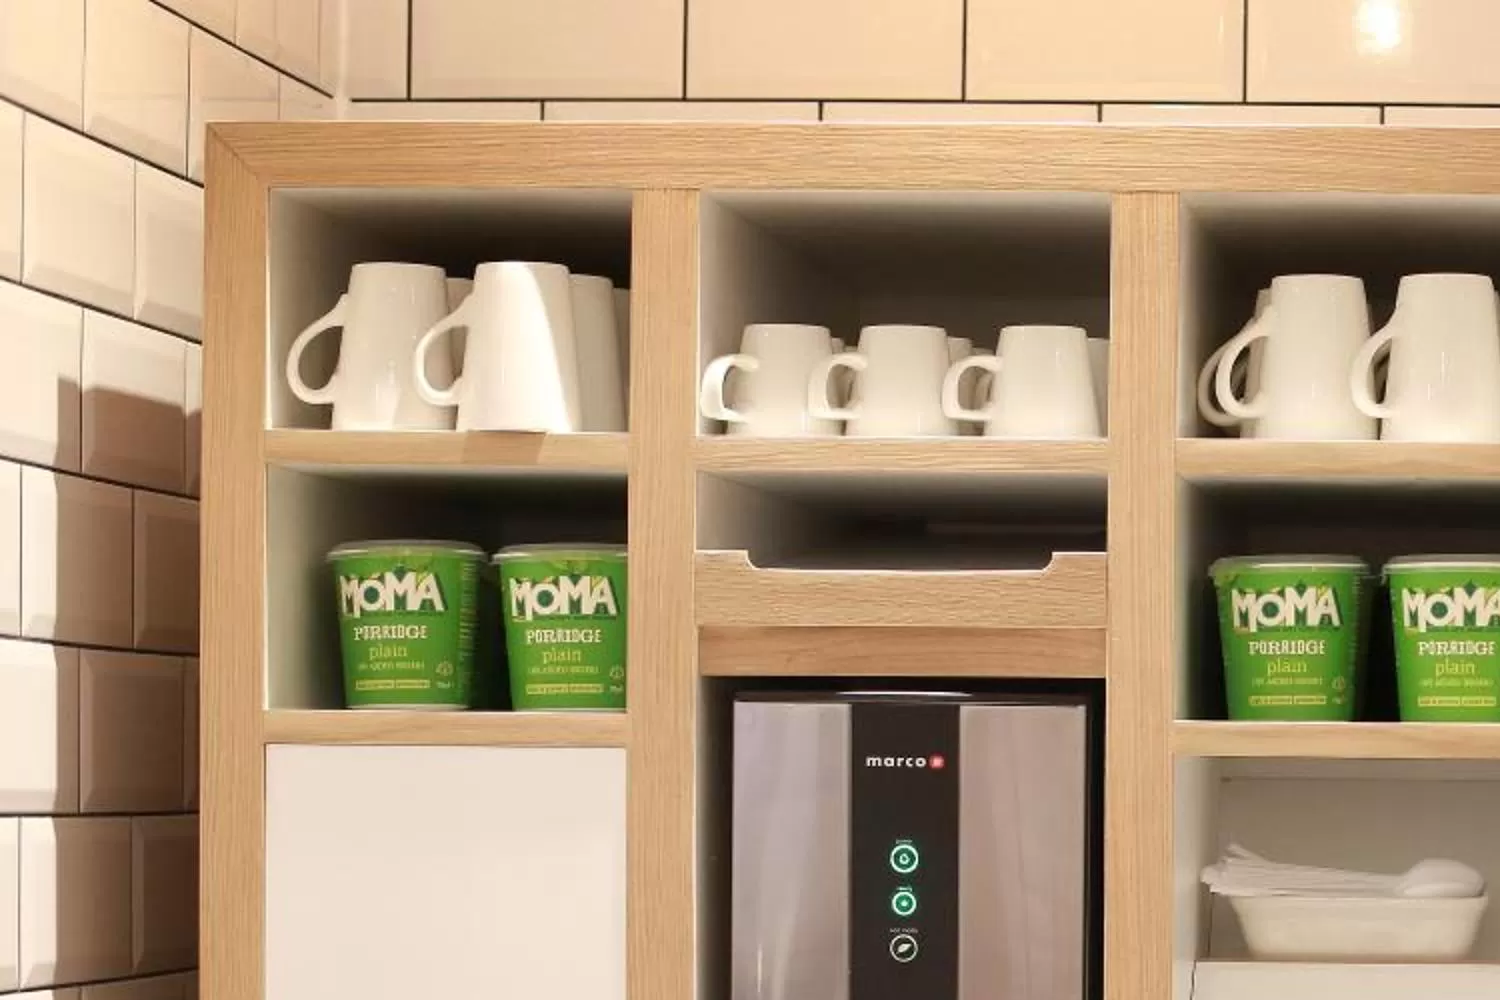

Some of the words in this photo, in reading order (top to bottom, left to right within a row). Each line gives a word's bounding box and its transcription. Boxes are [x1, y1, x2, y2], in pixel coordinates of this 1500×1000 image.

[340, 572, 445, 618] MOMA
[510, 576, 617, 620] MOMA
[1232, 586, 1340, 632] MOMA
[353, 624, 428, 640] PORRIDGE
[526, 629, 602, 644] PORRIDGE
[368, 643, 408, 660] plain
[1248, 639, 1325, 655] PORRIDGE
[1418, 640, 1496, 655] PORRIDGE
[542, 648, 581, 664] plain
[1267, 657, 1307, 676] plain
[1435, 657, 1475, 677] plain
[866, 756, 927, 768] marco
